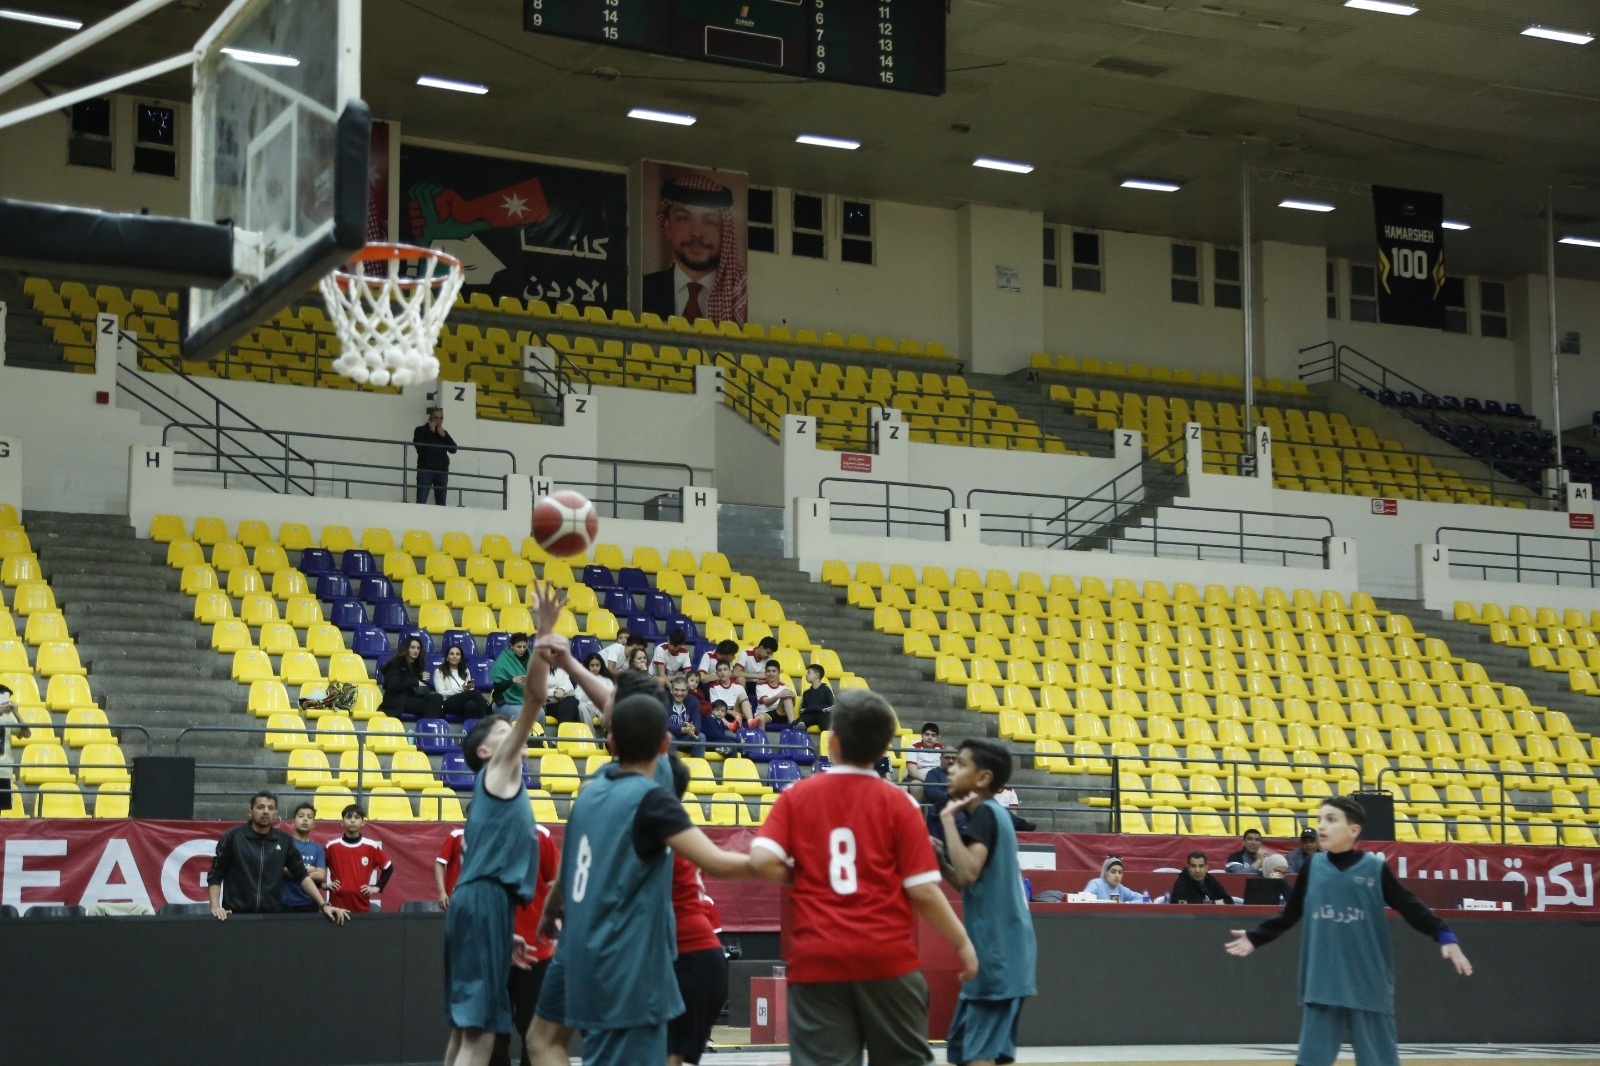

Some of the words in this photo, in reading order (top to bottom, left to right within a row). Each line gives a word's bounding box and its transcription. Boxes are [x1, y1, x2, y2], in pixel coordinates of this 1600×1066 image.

[533, 13, 543, 26] 9
[602, 9, 619, 23] 14
[815, 12, 824, 25] 6
[878, 6, 890, 19] 11
[602, 26, 619, 40] 15
[815, 28, 824, 41] 7
[878, 22, 893, 35] 12
[816, 45, 826, 58] 8
[878, 38, 893, 52] 13
[816, 61, 826, 74] 9
[879, 54, 894, 68] 14
[879, 71, 894, 84] 15
[1384, 224, 1434, 244] HAMARSHEH
[1391, 247, 1428, 280] 100
[101, 318, 115, 335] Z
[454, 386, 466, 401] Z
[575, 398, 587, 414] Z
[796, 420, 807, 434] Z
[889, 425, 900, 440] Z
[1190, 426, 1200, 440] Z
[1123, 433, 1133, 447] Z
[146, 451, 160, 468] H
[537, 480, 549, 496] H
[1575, 487, 1588, 499] A1
[694, 491, 707, 507] H
[1432, 548, 1440, 562] J
[829, 827, 858, 895] 8
[572, 834, 592, 903] 8
[1312, 905, 1364, 923] الزرقاء
